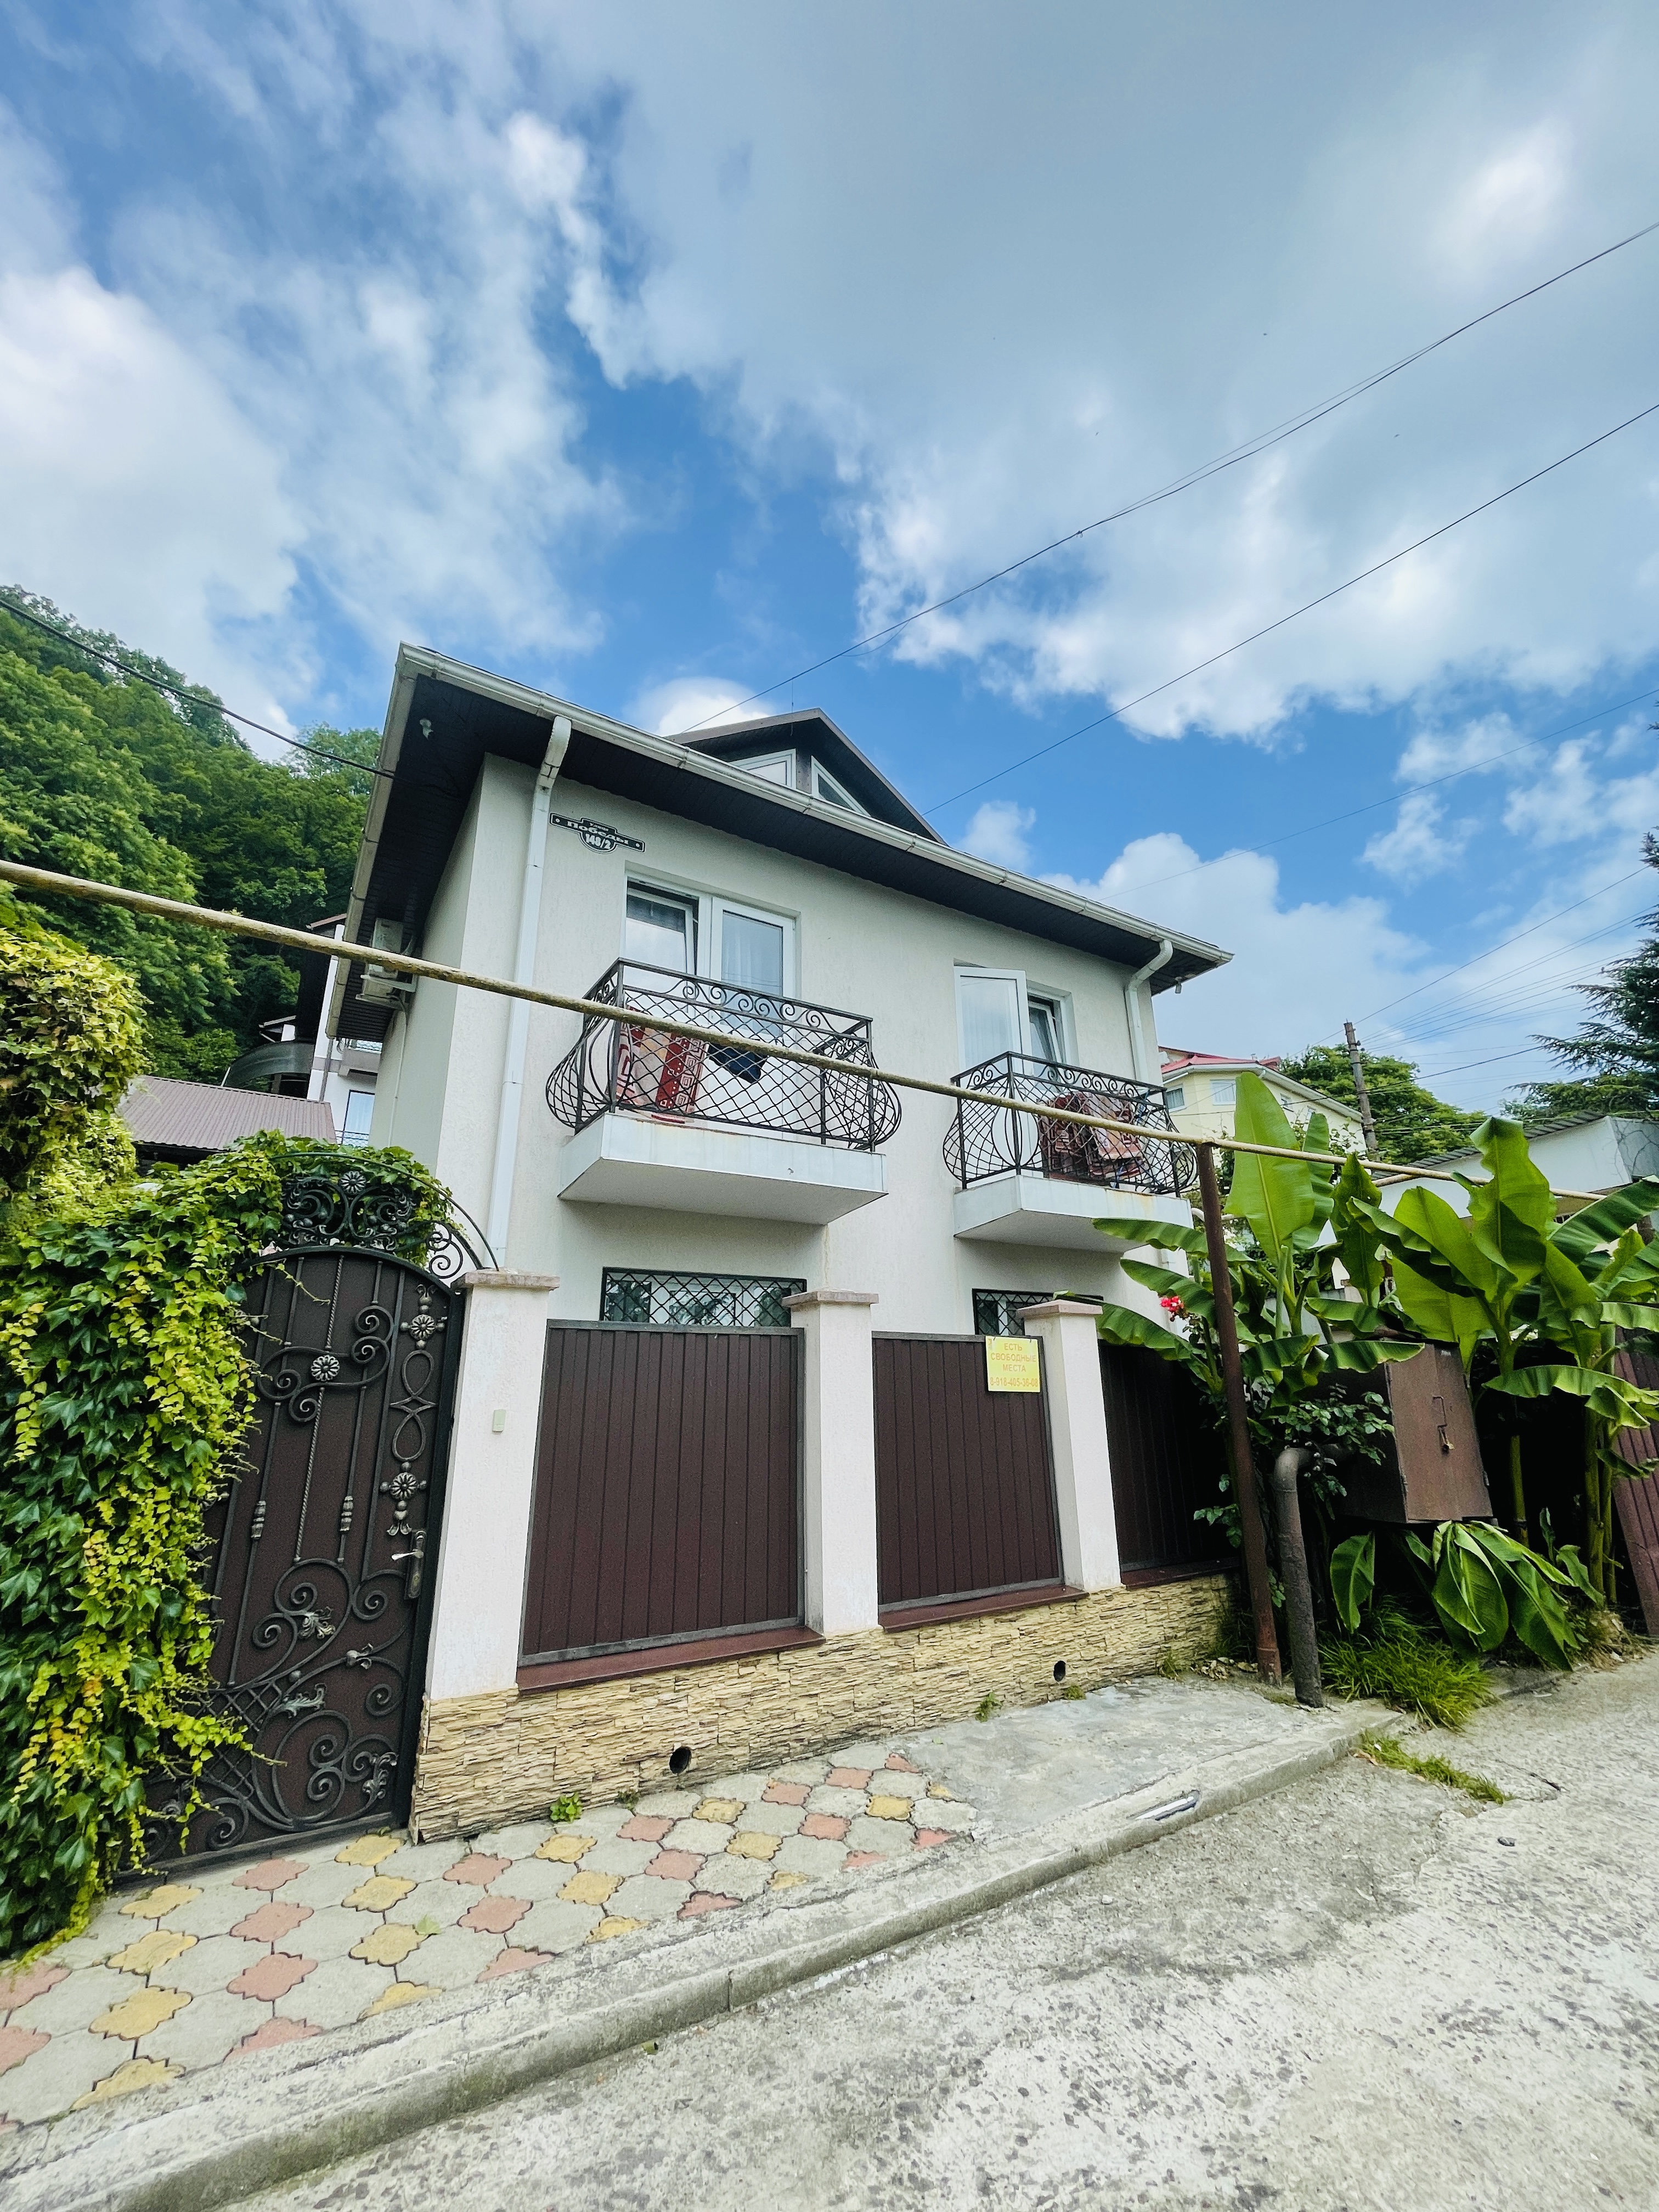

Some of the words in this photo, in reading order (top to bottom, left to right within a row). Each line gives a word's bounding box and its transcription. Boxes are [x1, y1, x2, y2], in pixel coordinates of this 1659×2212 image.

[567, 821, 629, 844] Победы
[585, 833, 611, 849] 148/2
[1004, 1342, 1023, 1351] ЕСТЬ
[990, 1352, 1037, 1362] СВОБОДНЫЕ
[1002, 1363, 1026, 1372] МЕСТА
